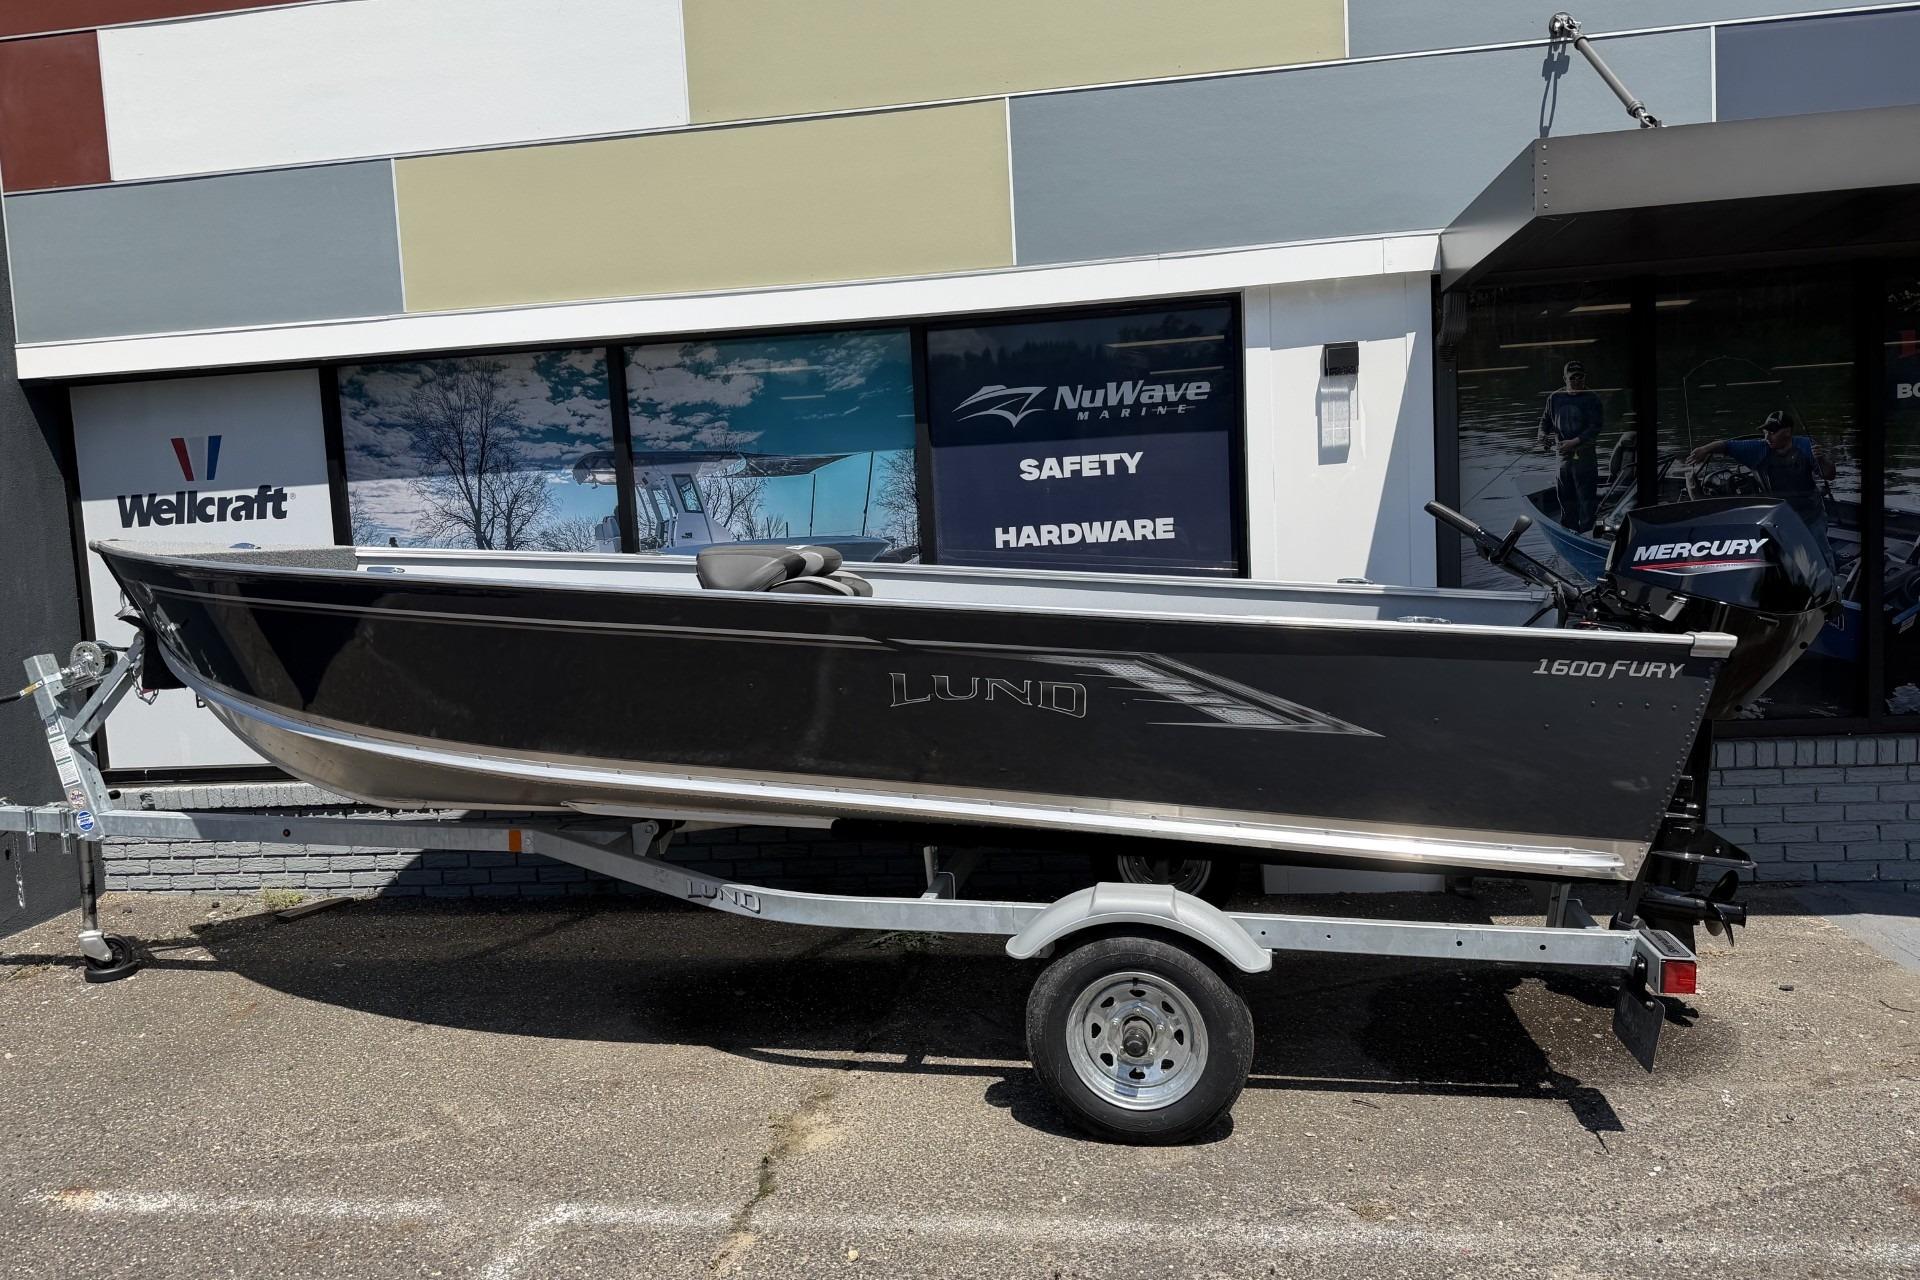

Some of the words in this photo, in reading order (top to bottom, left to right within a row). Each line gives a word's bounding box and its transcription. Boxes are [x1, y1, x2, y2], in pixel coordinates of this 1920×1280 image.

[1053, 380, 1211, 410] NuWave
[1077, 404, 1187, 420] MARINE
[1019, 452, 1143, 481] SAFETY
[117, 485, 288, 528] Wellcraft
[995, 517, 1175, 548] HARDWARE
[1633, 538, 1769, 562] MERCURY
[1532, 659, 1606, 677] 1600
[1608, 660, 1685, 679] FURY
[889, 673, 1086, 718] LUND
[687, 880, 760, 914] LUND
